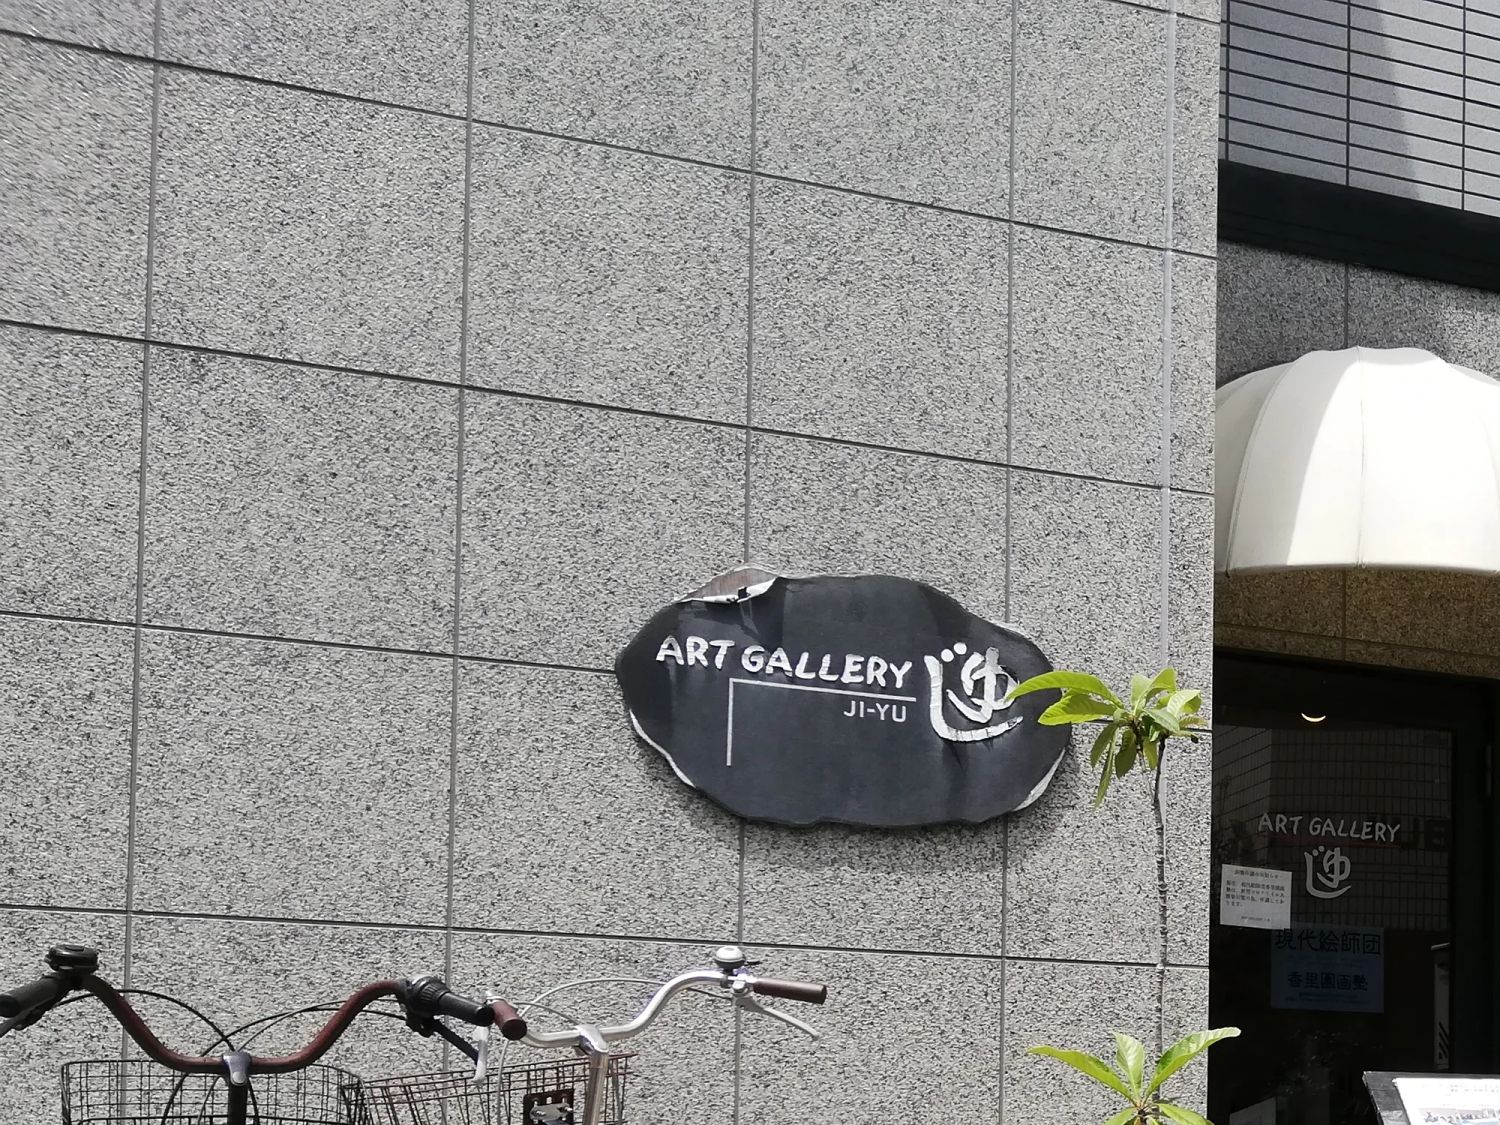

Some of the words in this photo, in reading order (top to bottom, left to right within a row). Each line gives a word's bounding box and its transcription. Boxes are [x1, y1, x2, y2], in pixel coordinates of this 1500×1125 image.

[656, 635, 735, 670] ART
[741, 645, 913, 689] GALLERY
[843, 700, 907, 723] JI-YU
[1258, 812, 1303, 836] ART
[1309, 817, 1400, 843] GALLERY
[1275, 927, 1382, 956] 現代絵師団
